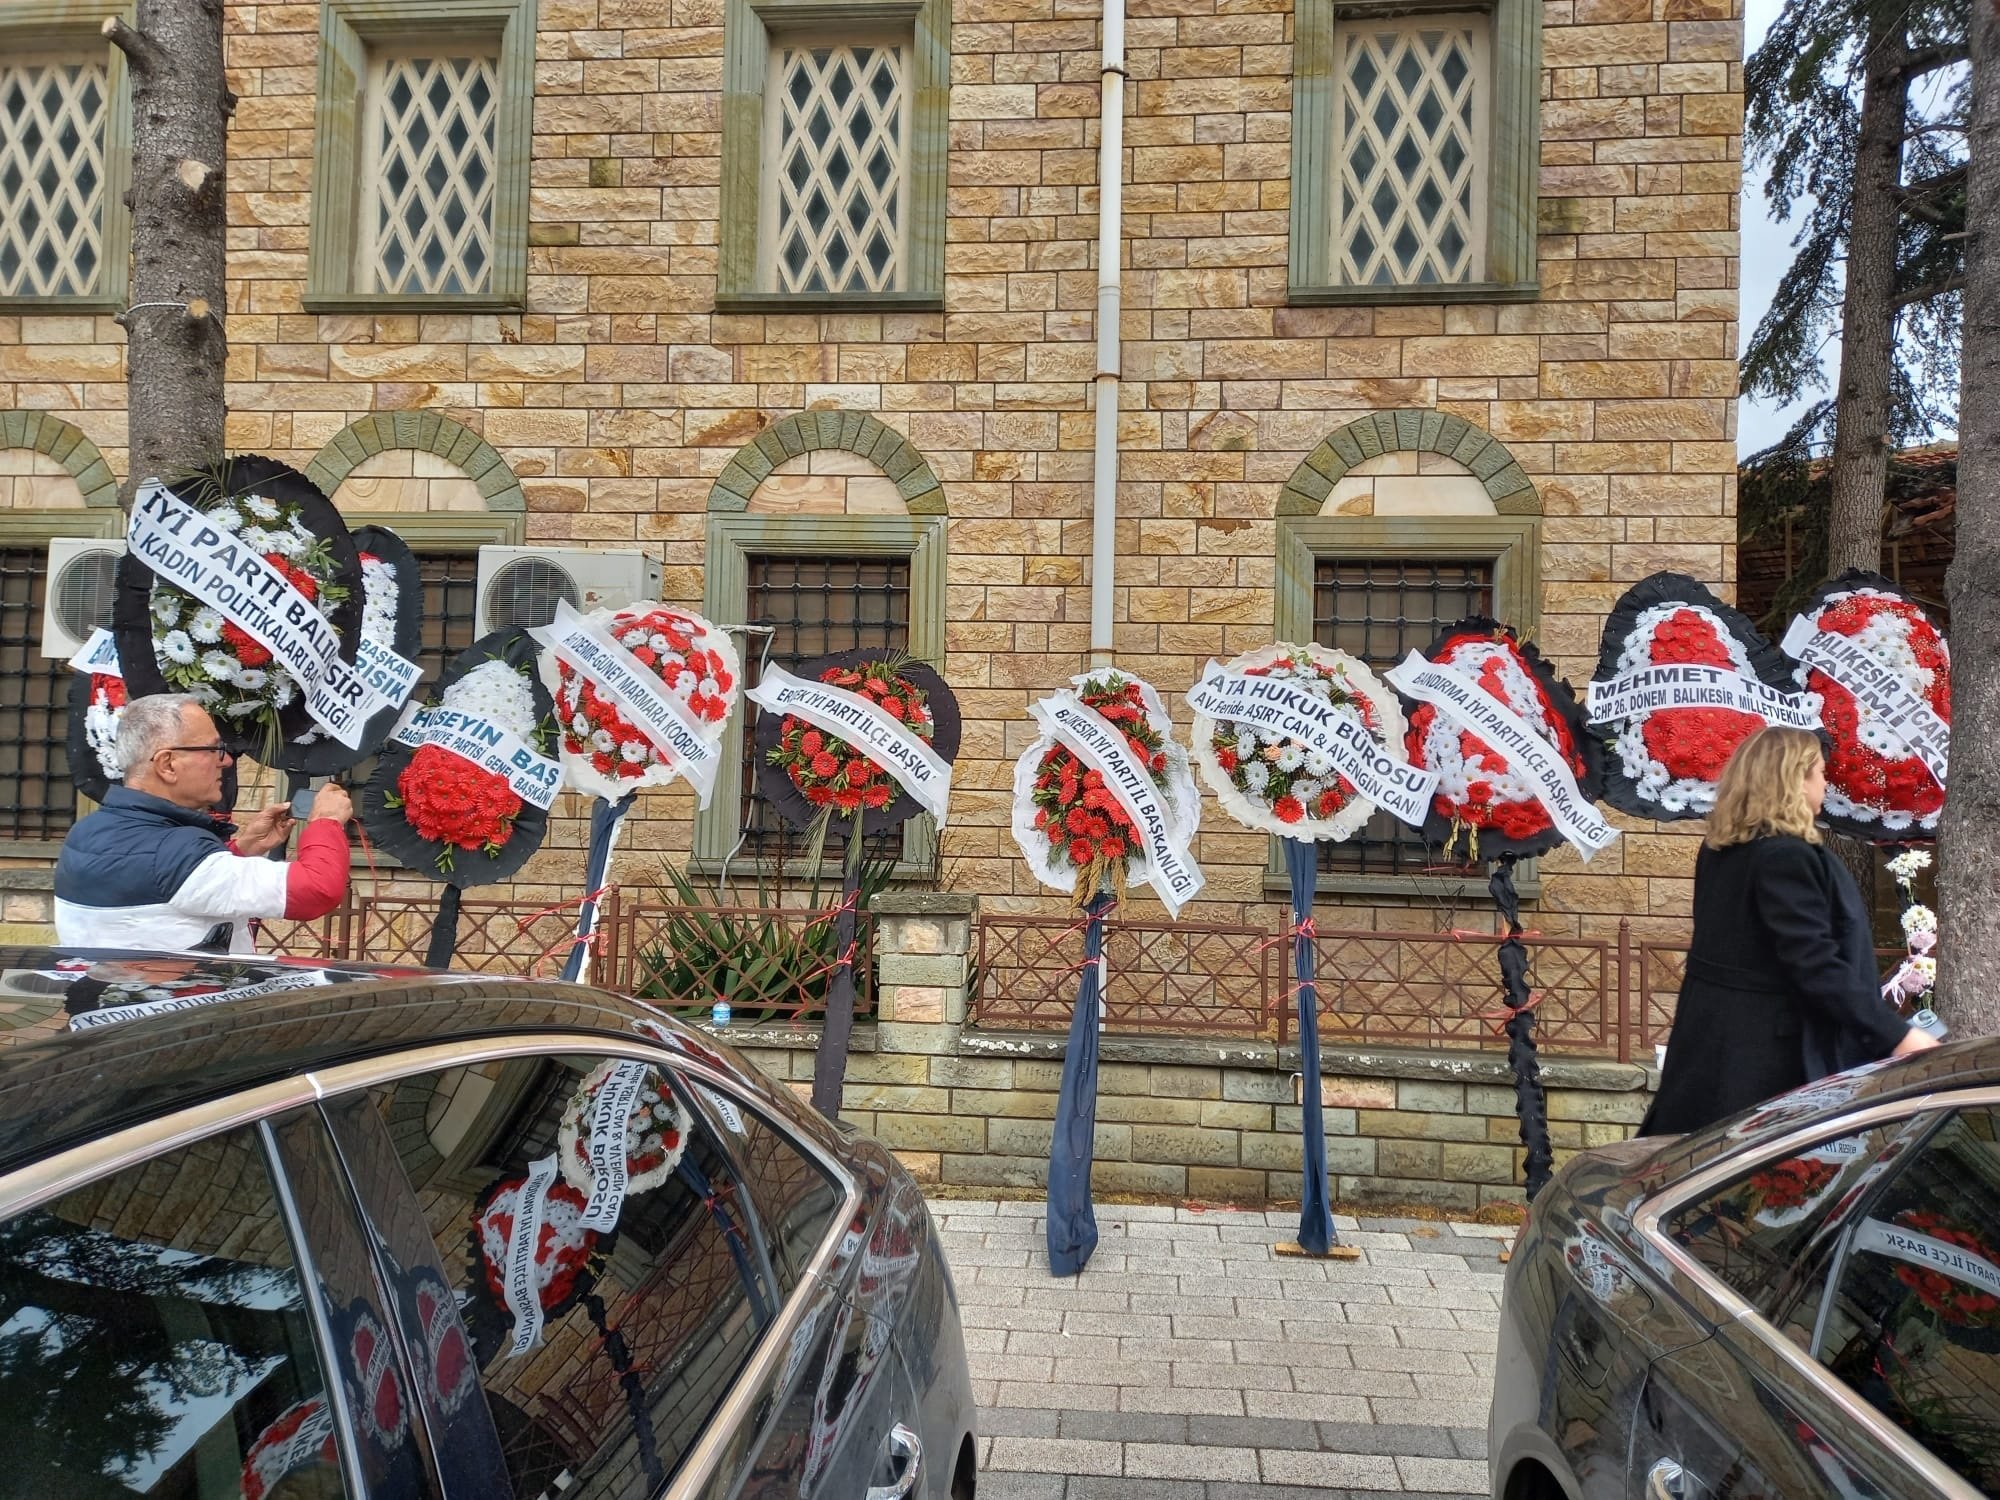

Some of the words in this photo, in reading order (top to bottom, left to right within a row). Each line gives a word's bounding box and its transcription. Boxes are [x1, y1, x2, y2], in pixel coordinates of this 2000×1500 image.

[142, 488, 194, 536] İYİ
[190, 526, 289, 608] PARTİ
[139, 531, 208, 585] KADIN
[203, 574, 309, 670] POLİTİKALARI
[617, 676, 669, 728] MARMARA
[1595, 667, 1723, 700] MEHMET
[1798, 648, 1906, 728] RAHMİ
[1808, 631, 1901, 699] BALIKESİR
[805, 690, 830, 708] İYİ
[821, 701, 866, 726] PARTİ
[858, 715, 892, 747] İLÇE
[1249, 681, 1336, 728] HUKUK
[1335, 721, 1427, 793] BÜROSU
[1594, 702, 1613, 720] CHP
[1614, 698, 1628, 715] 26.
[1630, 689, 1667, 711] DÖNEM
[1673, 687, 1734, 706] BALIKESİR
[451, 737, 489, 760] PARTİSİ
[513, 777, 553, 806] BAŞKANI
[510, 748, 560, 790] BAŞ
[1243, 703, 1284, 725] AŞIRT
[1282, 716, 1315, 740] CAN
[1313, 732, 1328, 749] &
[1382, 789, 1416, 815] CAN
[1412, 672, 1470, 706] BANDIRMA
[1463, 698, 1491, 719] İYİ
[1481, 714, 1527, 748] PARTİ
[1517, 740, 1549, 773] İLÇE
[1540, 769, 1609, 843] BAŞKANLIĞI
[1091, 734, 1112, 755] İYİ
[1103, 751, 1143, 792] PARTİ
[1130, 788, 1148, 805] İL
[1140, 803, 1192, 894] BAŞKANLIĞI
